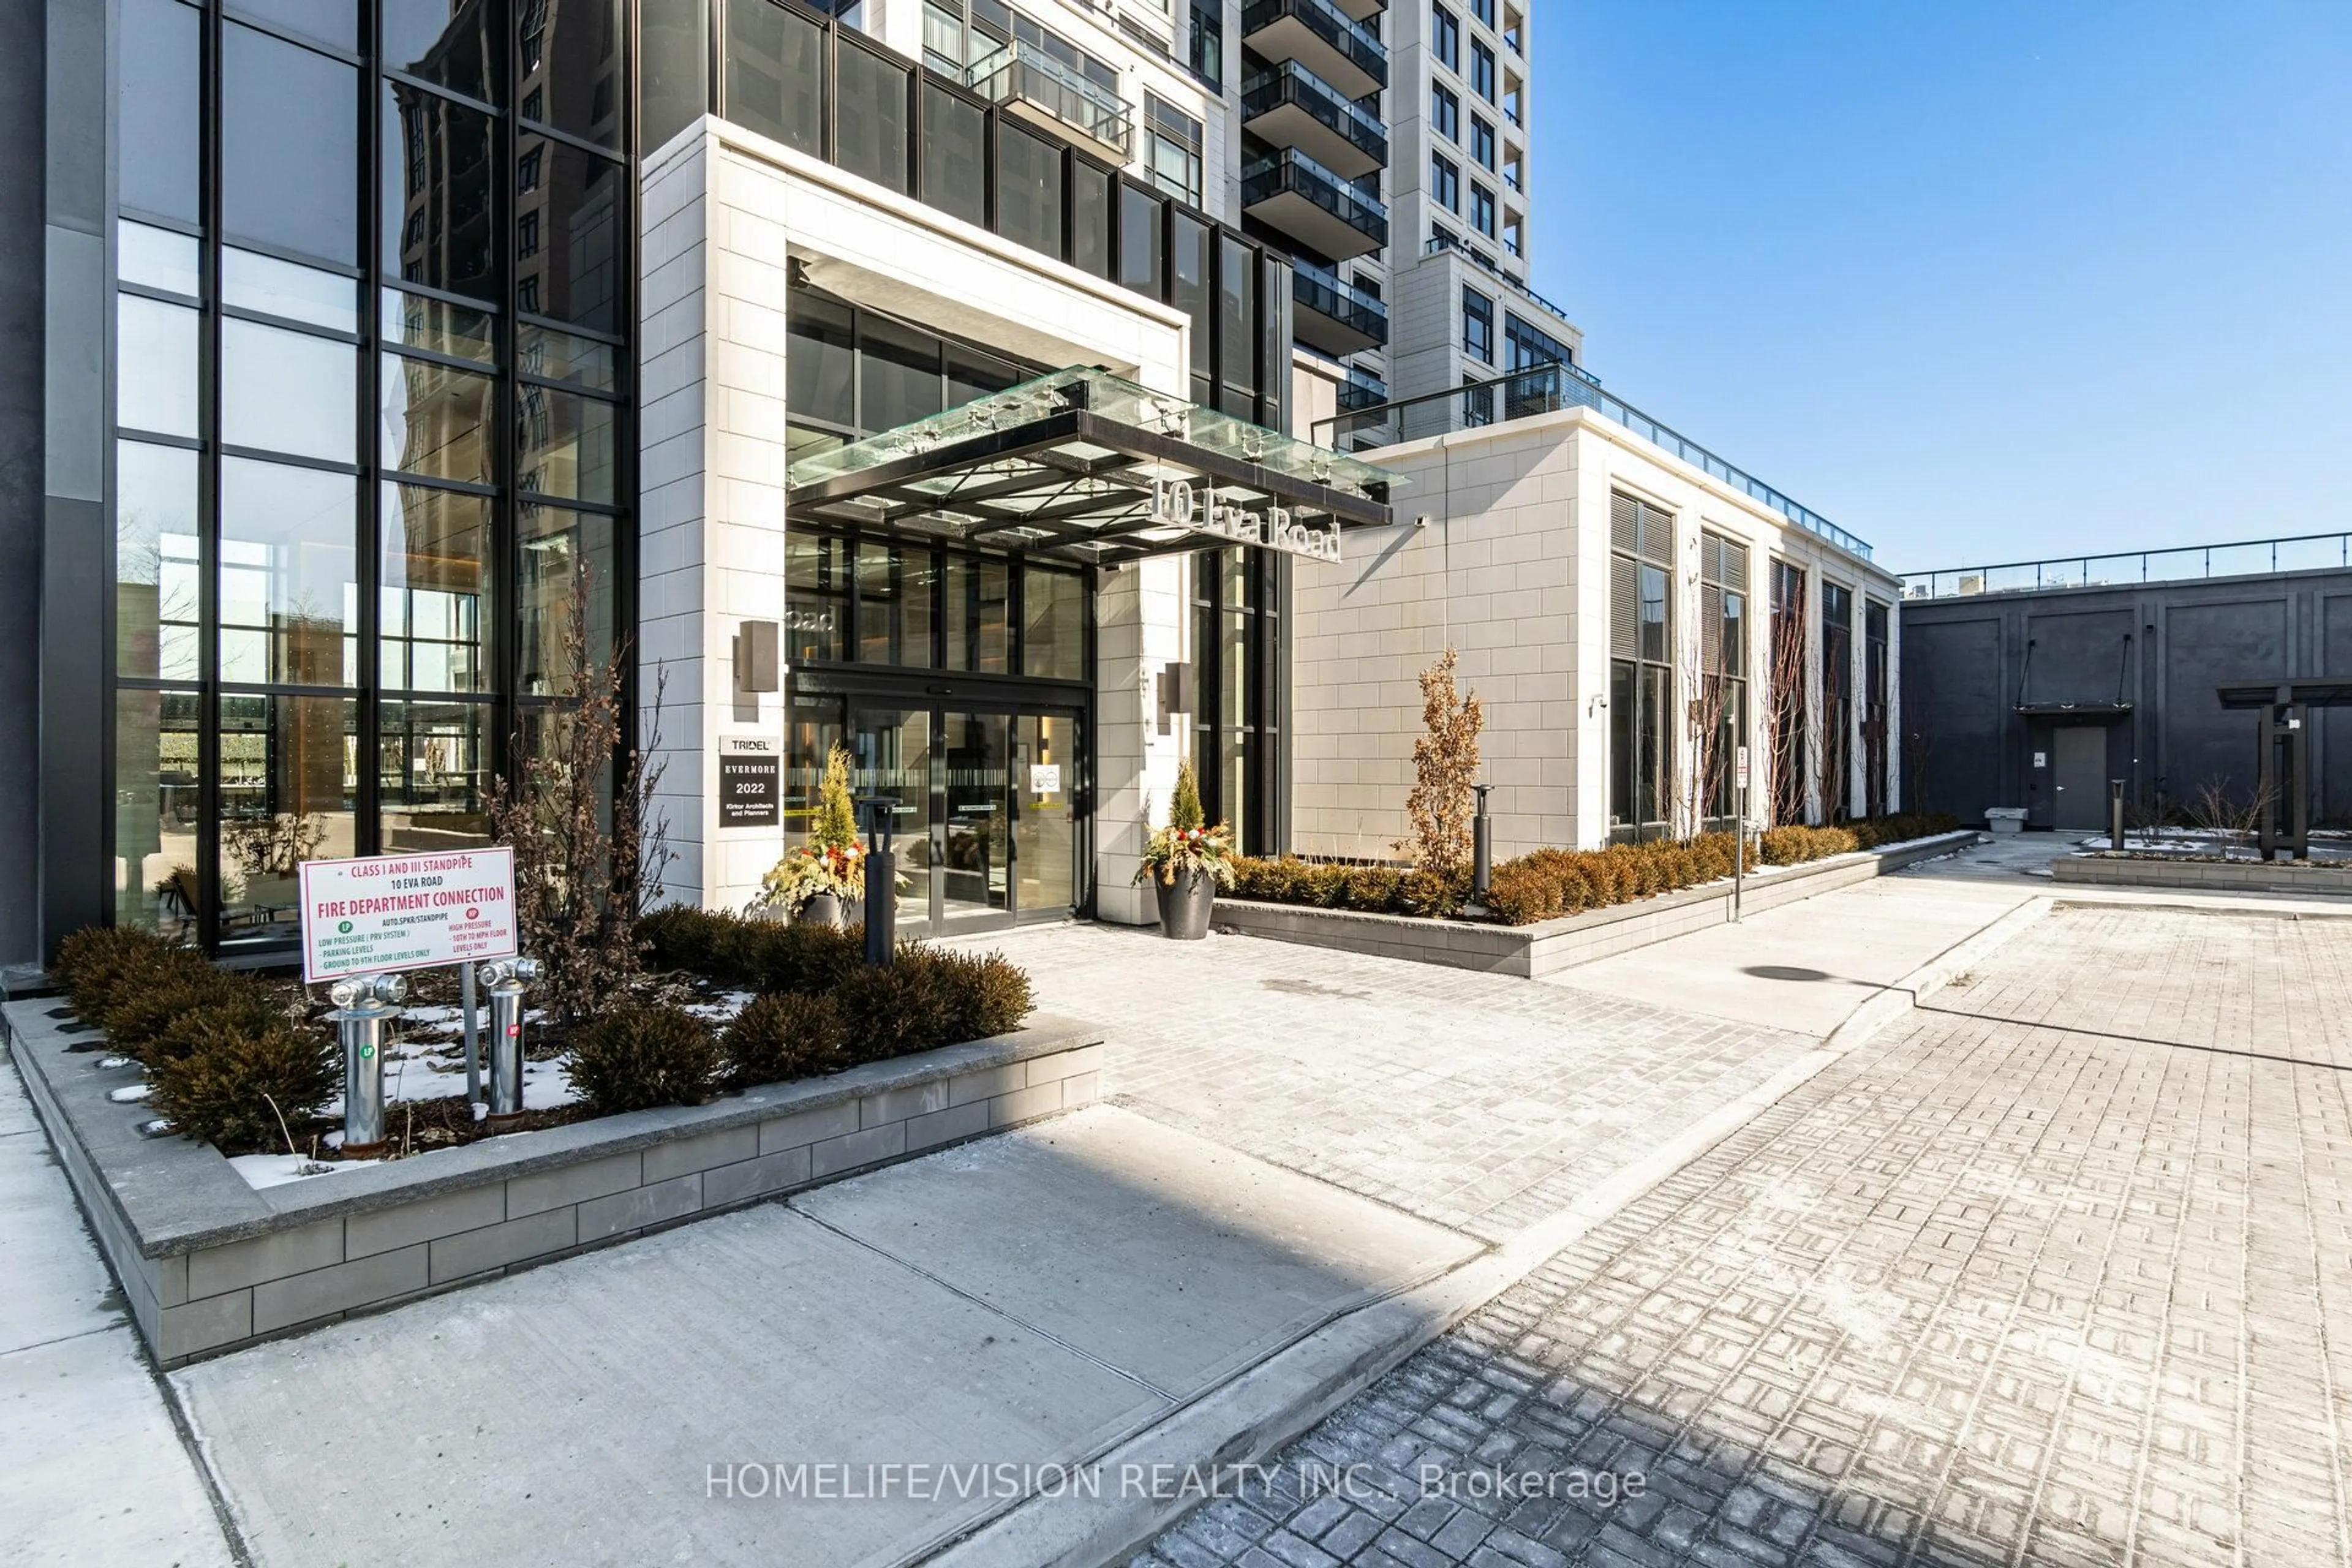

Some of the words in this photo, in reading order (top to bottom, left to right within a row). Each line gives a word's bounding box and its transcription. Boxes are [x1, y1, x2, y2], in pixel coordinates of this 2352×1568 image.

[1145, 476, 1193, 522] 10
[1201, 488, 1261, 544] Eva
[1267, 506, 1341, 564] Road
[731, 740, 769, 750] TRIDEL
[725, 765, 775, 774] EVERMORE
[736, 783, 765, 794] 2022
[351, 864, 380, 878] CLASS
[383, 865, 386, 875] I
[388, 863, 408, 875] AND
[411, 861, 421, 873] III
[423, 858, 473, 872] STANDPIPE
[391, 879, 402, 890] 10
[404, 878, 419, 889] EVA
[421, 876, 443, 886] ROAD
[318, 900, 346, 919] FIRE
[350, 892, 430, 915] DEPARTMENT
[433, 886, 505, 907] CONNECTION
[341, 922, 350, 932] LP
[448, 923, 464, 932] HIGH
[464, 920, 492, 930] PRESSURE
[318, 938, 333, 948] LOW
[334, 934, 365, 945] PRESSURE
[467, 932, 475, 941] TO
[490, 929, 508, 938] FLOOR
[323, 948, 351, 958] PARKING
[352, 944, 374, 954] LEVELS
[453, 943, 473, 953] LEVELS
[323, 959, 350, 970] GROUND
[360, 956, 373, 965] 9TH
[373, 954, 393, 963] FLOOR
[393, 951, 415, 960] LEVELS
[415, 949, 431, 957] ONLY
[363, 1047, 373, 1057] LP
